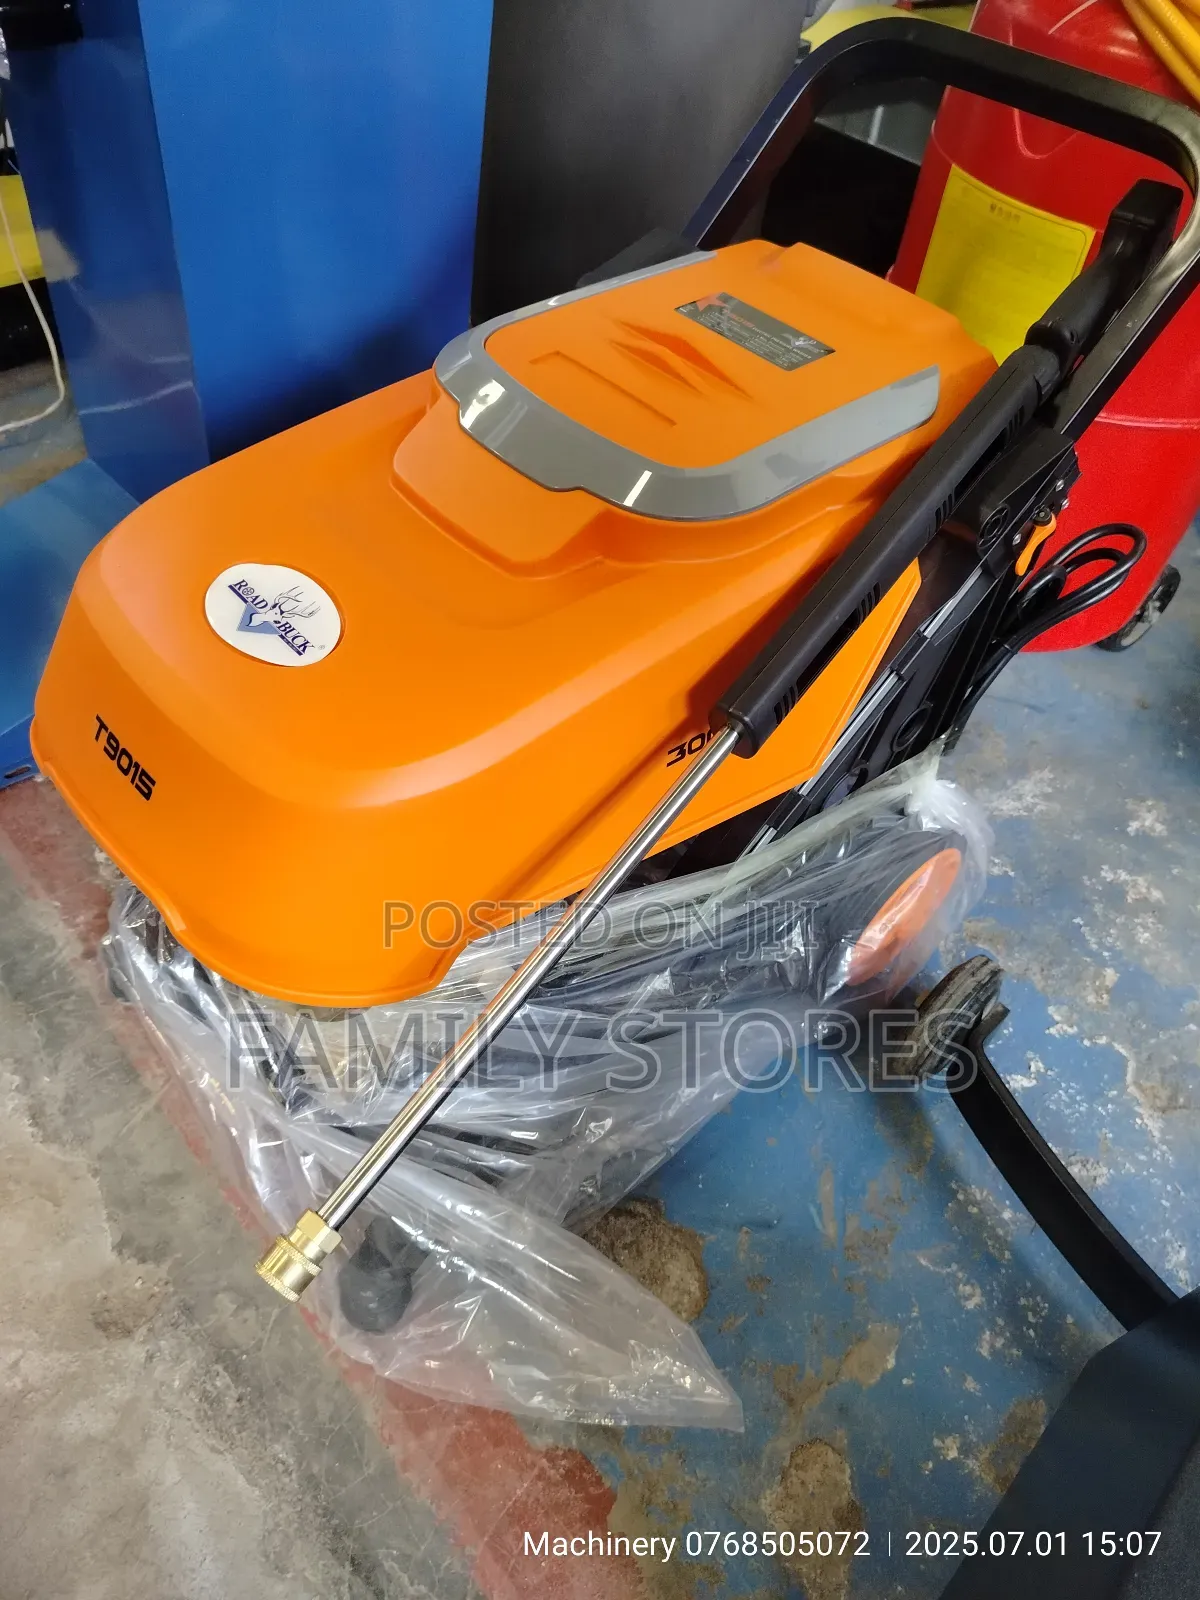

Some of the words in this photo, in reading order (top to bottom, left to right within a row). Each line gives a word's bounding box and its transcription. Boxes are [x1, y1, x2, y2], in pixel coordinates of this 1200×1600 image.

[233, 579, 269, 610] ROAD
[277, 621, 315, 654] BUCK
[94, 713, 157, 801] T9015
